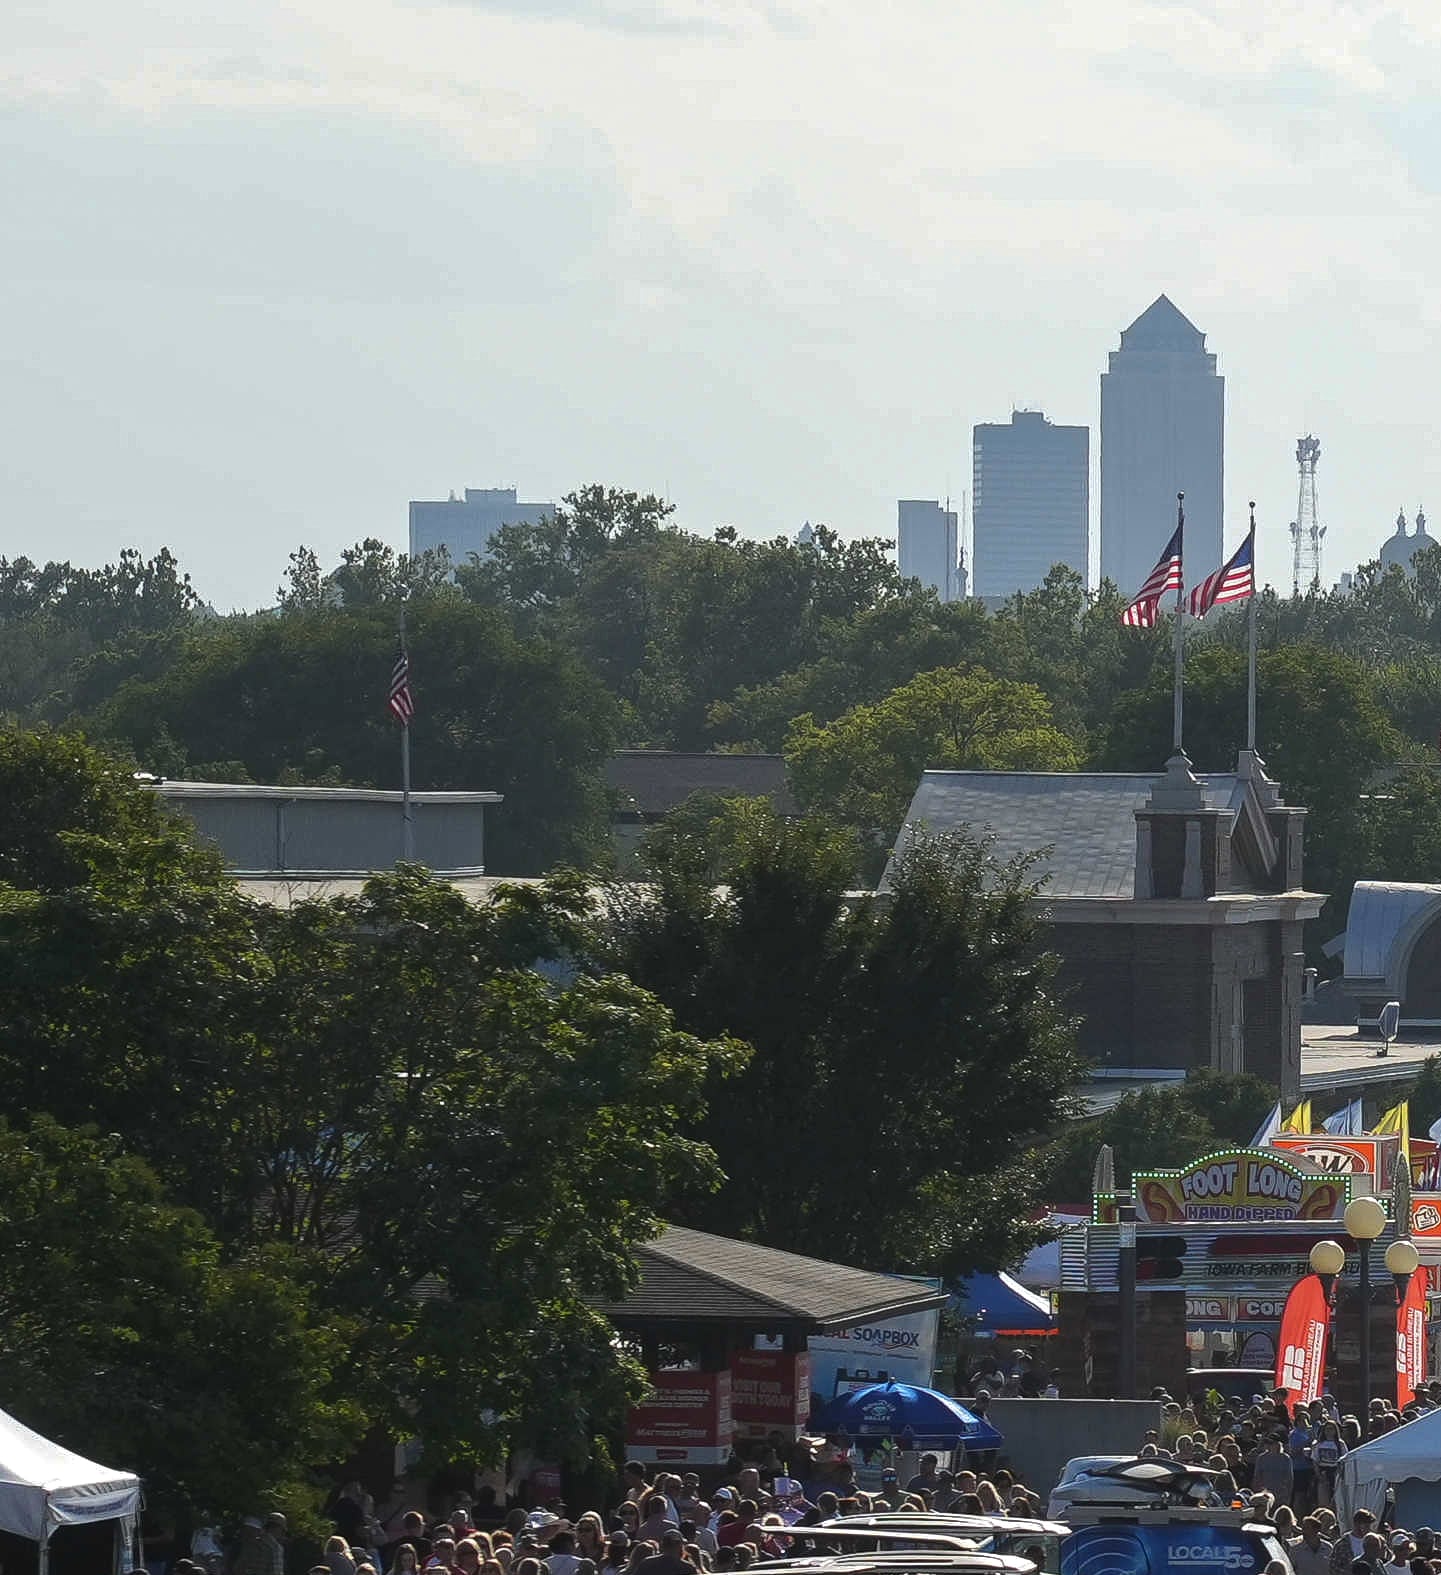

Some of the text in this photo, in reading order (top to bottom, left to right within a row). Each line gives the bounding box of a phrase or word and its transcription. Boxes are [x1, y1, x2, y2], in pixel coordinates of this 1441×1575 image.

[1181, 1162, 1303, 1201] FOOT LONG
[1188, 1205, 1234, 1220] HAND
[1206, 1263, 1245, 1276] IOWA
[1247, 1263, 1292, 1276] FARM
[854, 1328, 919, 1347] SOAPBOX
